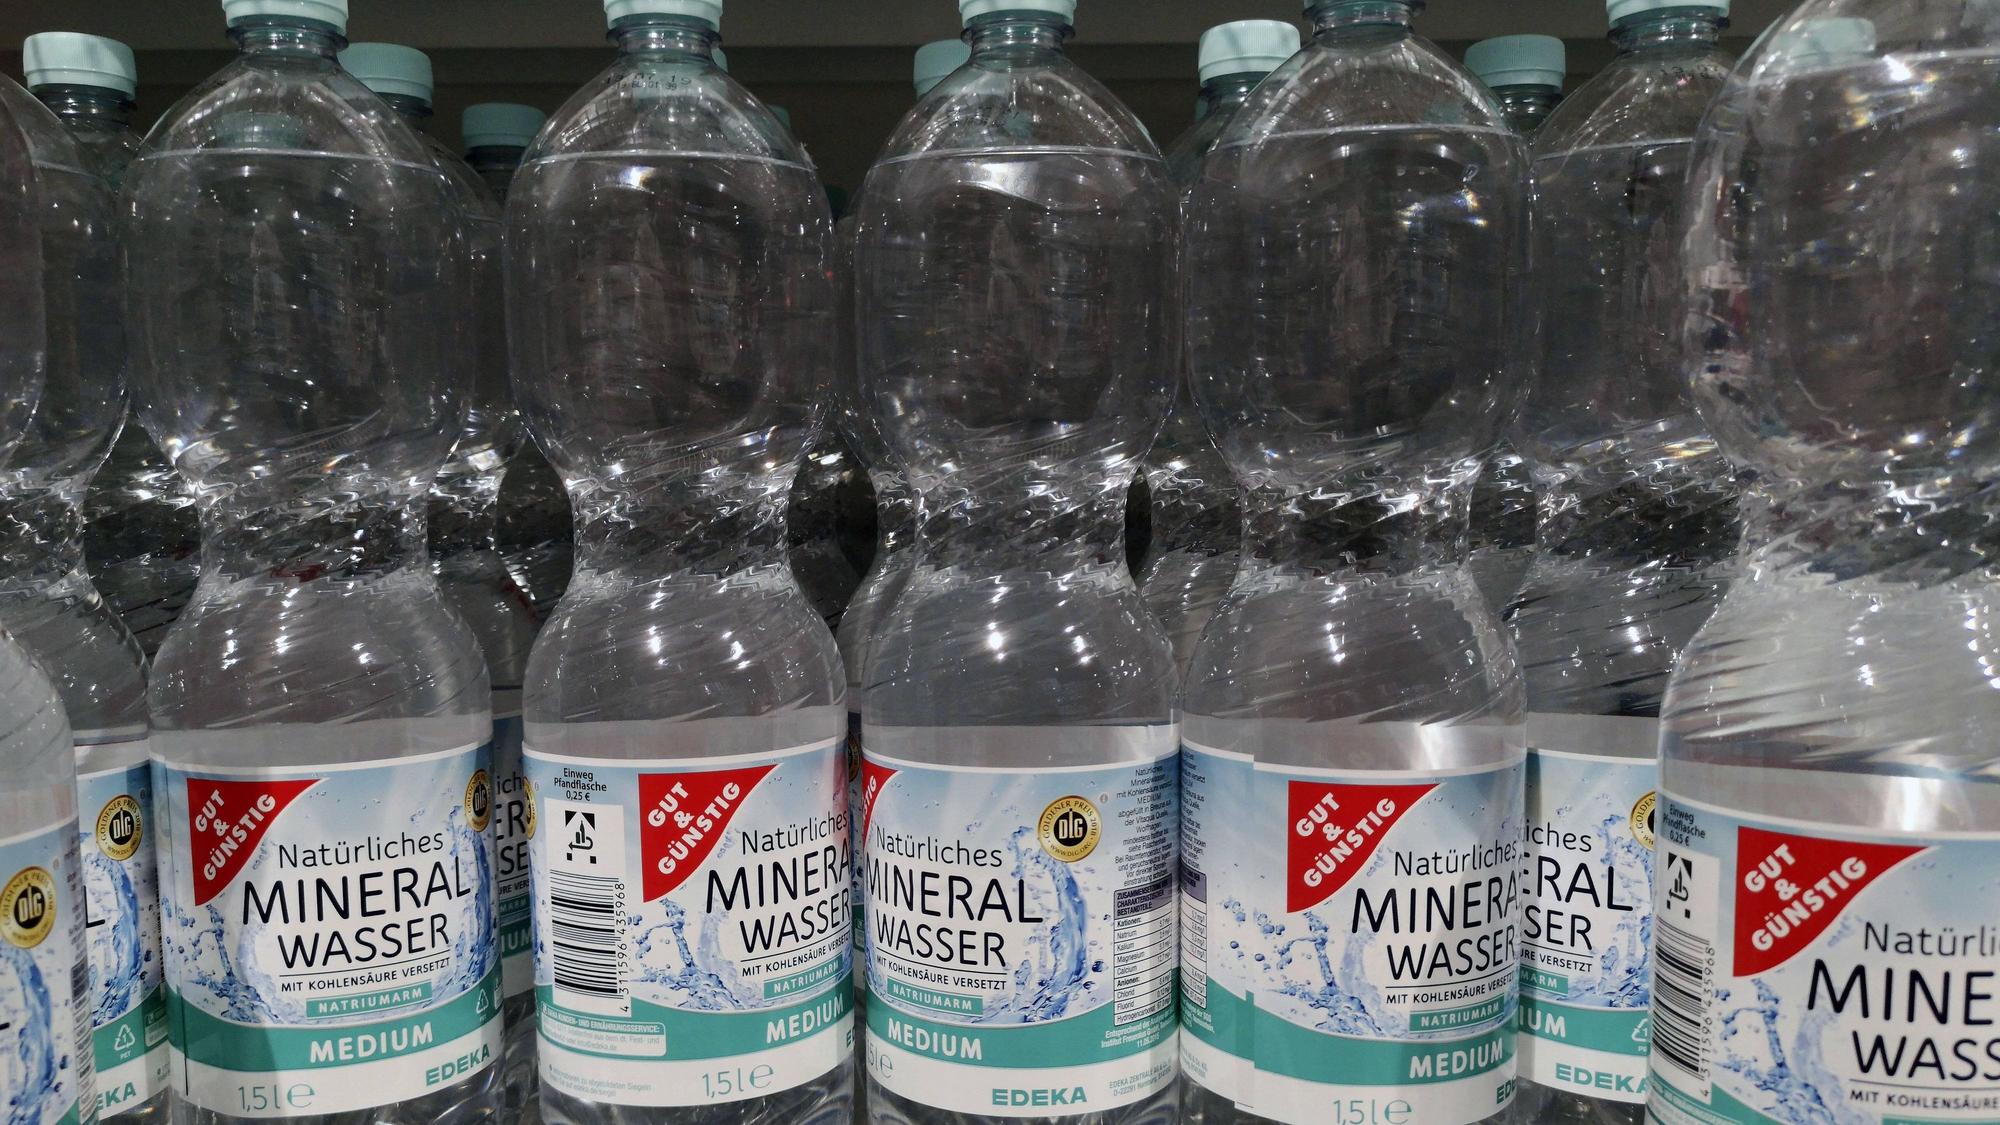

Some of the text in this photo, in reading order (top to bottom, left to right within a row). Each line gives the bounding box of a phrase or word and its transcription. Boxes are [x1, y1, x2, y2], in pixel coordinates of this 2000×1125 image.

[553, 778, 607, 792] Pfandflasche
[563, 768, 594, 782] Einweg
[195, 789, 225, 832] GUT
[565, 790, 591, 801] 0,25 €
[647, 781, 690, 828] GUT
[1295, 792, 1341, 837] GUT
[1635, 794, 1656, 830] GOLDEN
[1669, 804, 1695, 825] Einweg
[112, 809, 132, 840] DLG
[203, 794, 276, 881] GÜNSTIG
[213, 819, 231, 837] &
[657, 782, 741, 875] GÜNSTIG
[673, 810, 696, 829] &
[742, 810, 848, 856] Natürliches
[1042, 800, 1071, 839] GOLDENER
[1074, 800, 1094, 817] PREIS
[1058, 811, 1083, 839] DLG
[1322, 822, 1345, 842] &
[1663, 813, 1706, 839] Pfandflasche
[278, 832, 444, 869] Natürliches
[876, 825, 1003, 868] Natürliches
[1303, 797, 1396, 888] GÜNSTIG
[1394, 839, 1517, 877] Natürliches
[705, 837, 849, 914] MINERA
[1744, 843, 1796, 893] GUT
[242, 855, 471, 925] MINERAL
[866, 852, 1044, 923] MINERAL
[1351, 869, 1518, 934] MINERA
[1751, 856, 1867, 951] GÜNSTIG
[1773, 878, 1802, 901] &
[739, 888, 850, 954] WASSER
[876, 909, 1006, 967] WASSER
[1523, 904, 1593, 951] SER
[1864, 921, 2000, 957] Natürli
[277, 913, 450, 969] WASSER
[1386, 924, 1516, 980] WASSER
[281, 957, 450, 992] MIT KOHLENSÄURE VERSETZT
[742, 965, 762, 977] MIT
[765, 945, 827, 973] KOHLENSÄURE
[773, 959, 840, 994] NATRIUMARM
[876, 954, 1007, 991] MIT KOHLENSÄURE VERSETZT
[1539, 953, 1593, 974] VERSETZT
[318, 988, 423, 1013] NATRIUMARM
[892, 983, 973, 1011] NATRIUMARM
[1386, 994, 1408, 1005] MIT
[1413, 985, 1486, 1004] KOHLENSÄURE
[1807, 958, 1995, 1026] MINE
[766, 993, 844, 1044] MEDIUM
[1420, 1002, 1500, 1028] NATRIUMARM
[1519, 1005, 1566, 1038] IUM
[309, 1022, 433, 1063] MEDIUM
[887, 1017, 983, 1061] MEDIUM
[1408, 1037, 1504, 1079] MEDIUM
[1851, 1030, 2000, 1082] WASS
[425, 1043, 491, 1086] EDEKA
[97, 1082, 137, 1112] EKA
[992, 1086, 1088, 1107] EDEKA
[1850, 1089, 1999, 1110] MIT KOHLENSÄURE
